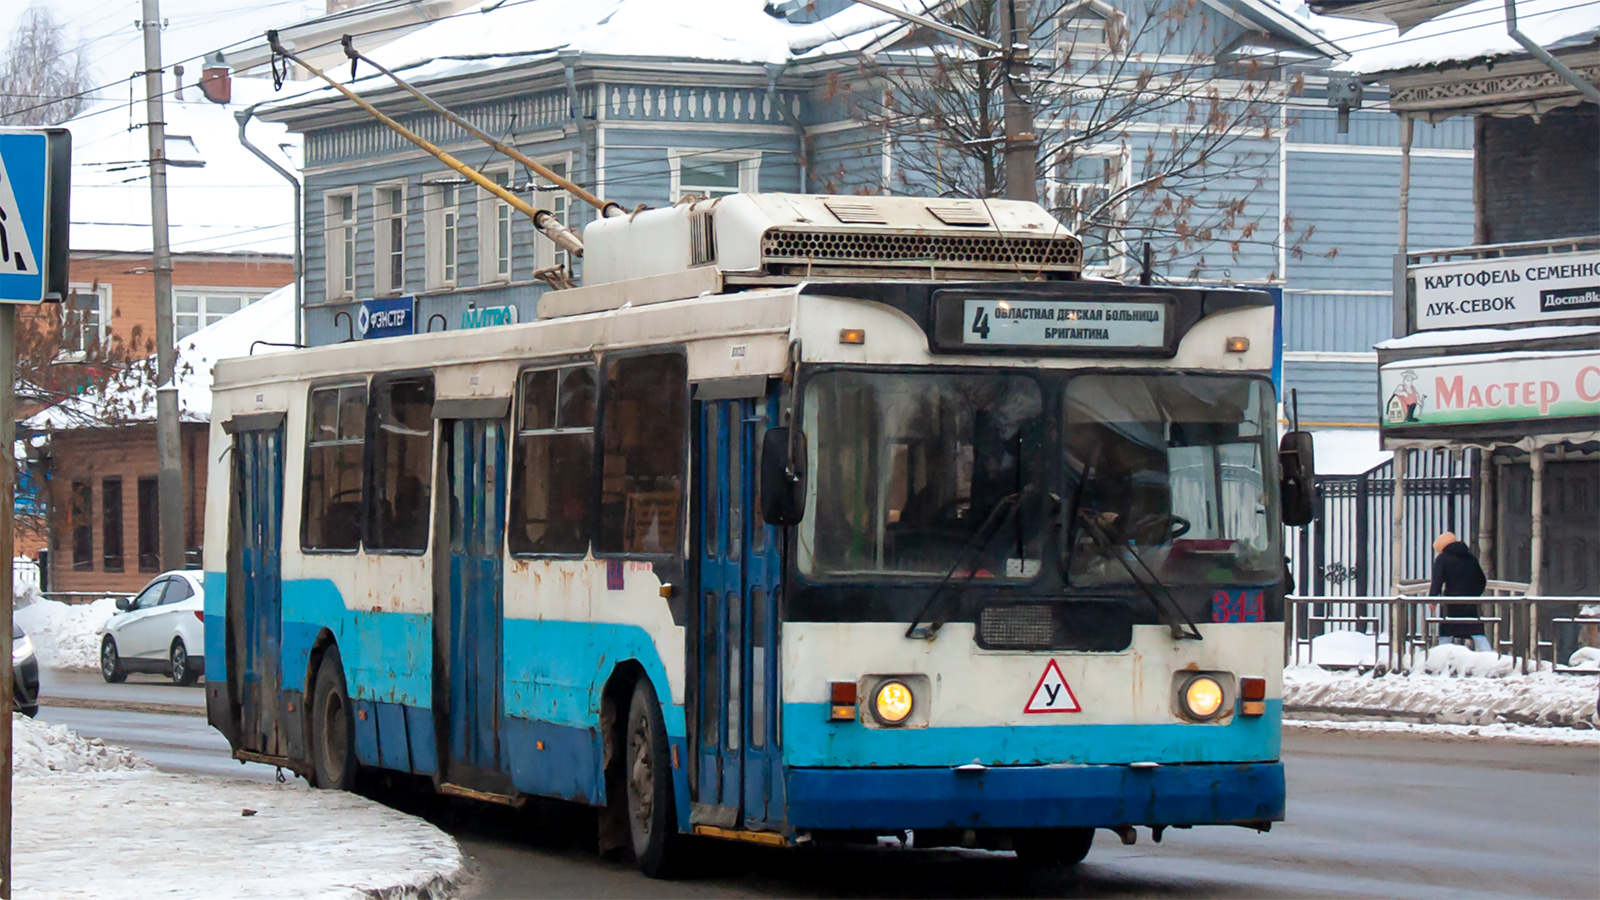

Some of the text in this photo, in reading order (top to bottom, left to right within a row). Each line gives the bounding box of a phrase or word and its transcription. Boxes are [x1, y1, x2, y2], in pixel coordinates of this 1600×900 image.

[1425, 270, 1521, 290] КАРТОФЕЛЬ
[994, 307, 1159, 323] ОБЛАСТНАЯ ДЕТСКАЯ БОЛЬНИЦА
[1426, 296, 1516, 317] ЛУК-СЕВОК
[370, 309, 406, 329] ФЭНСТЕР
[971, 306, 990, 340] 4
[1044, 327, 1109, 340] БРИГАНТИНА
[1211, 590, 1266, 623] 344
